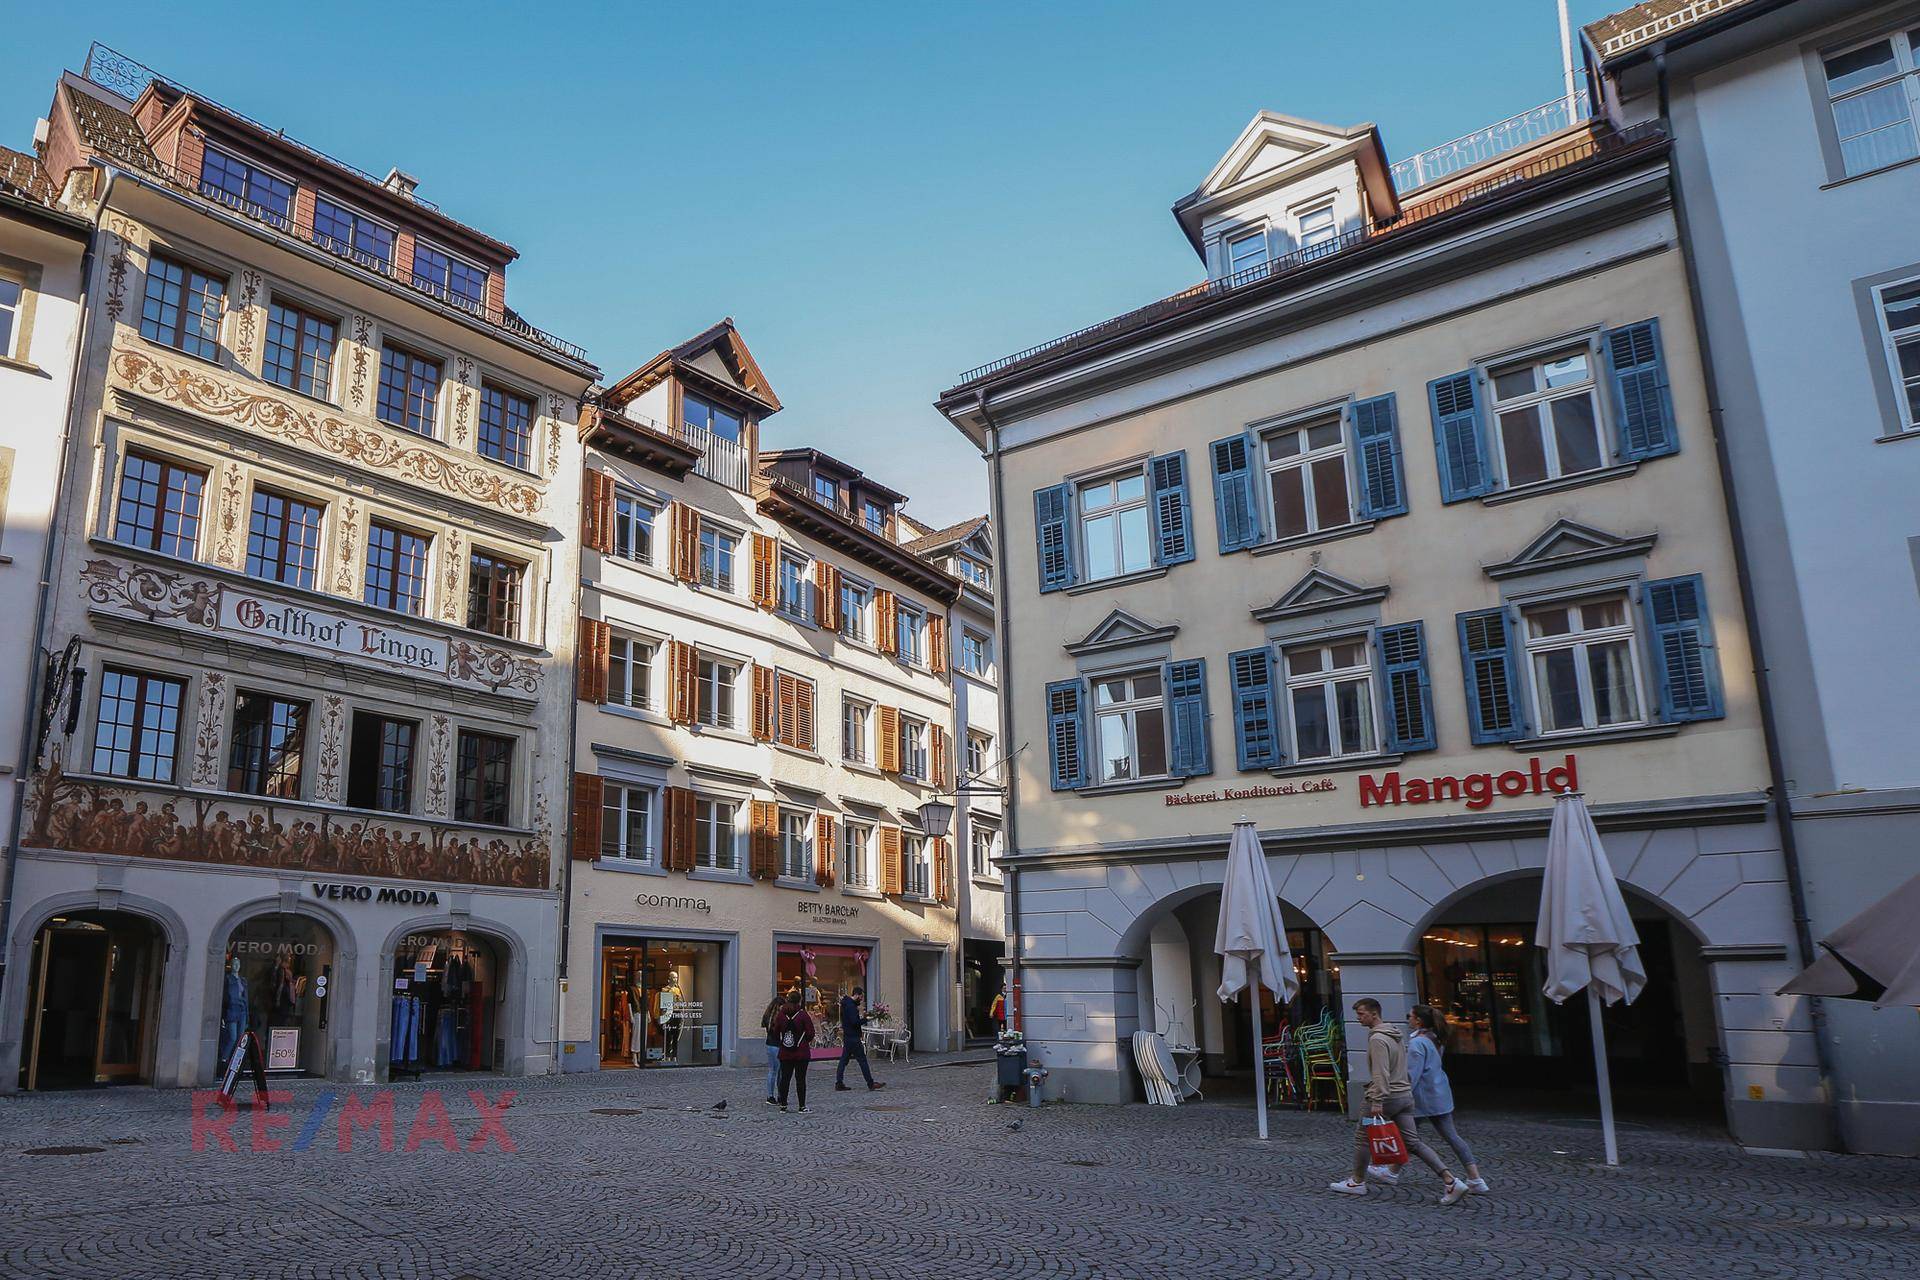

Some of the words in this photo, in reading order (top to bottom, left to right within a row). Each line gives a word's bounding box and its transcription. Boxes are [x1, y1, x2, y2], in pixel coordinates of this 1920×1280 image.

[236, 598, 348, 647] Gasthof
[1358, 754, 1578, 811] Mangold
[312, 883, 372, 901] VERO
[376, 888, 439, 905] MODA
[798, 901, 823, 914] BETTY
[825, 904, 859, 918] BARCLAY
[226, 941, 272, 954] VERO
[272, 1048, 295, 1058] -50%
